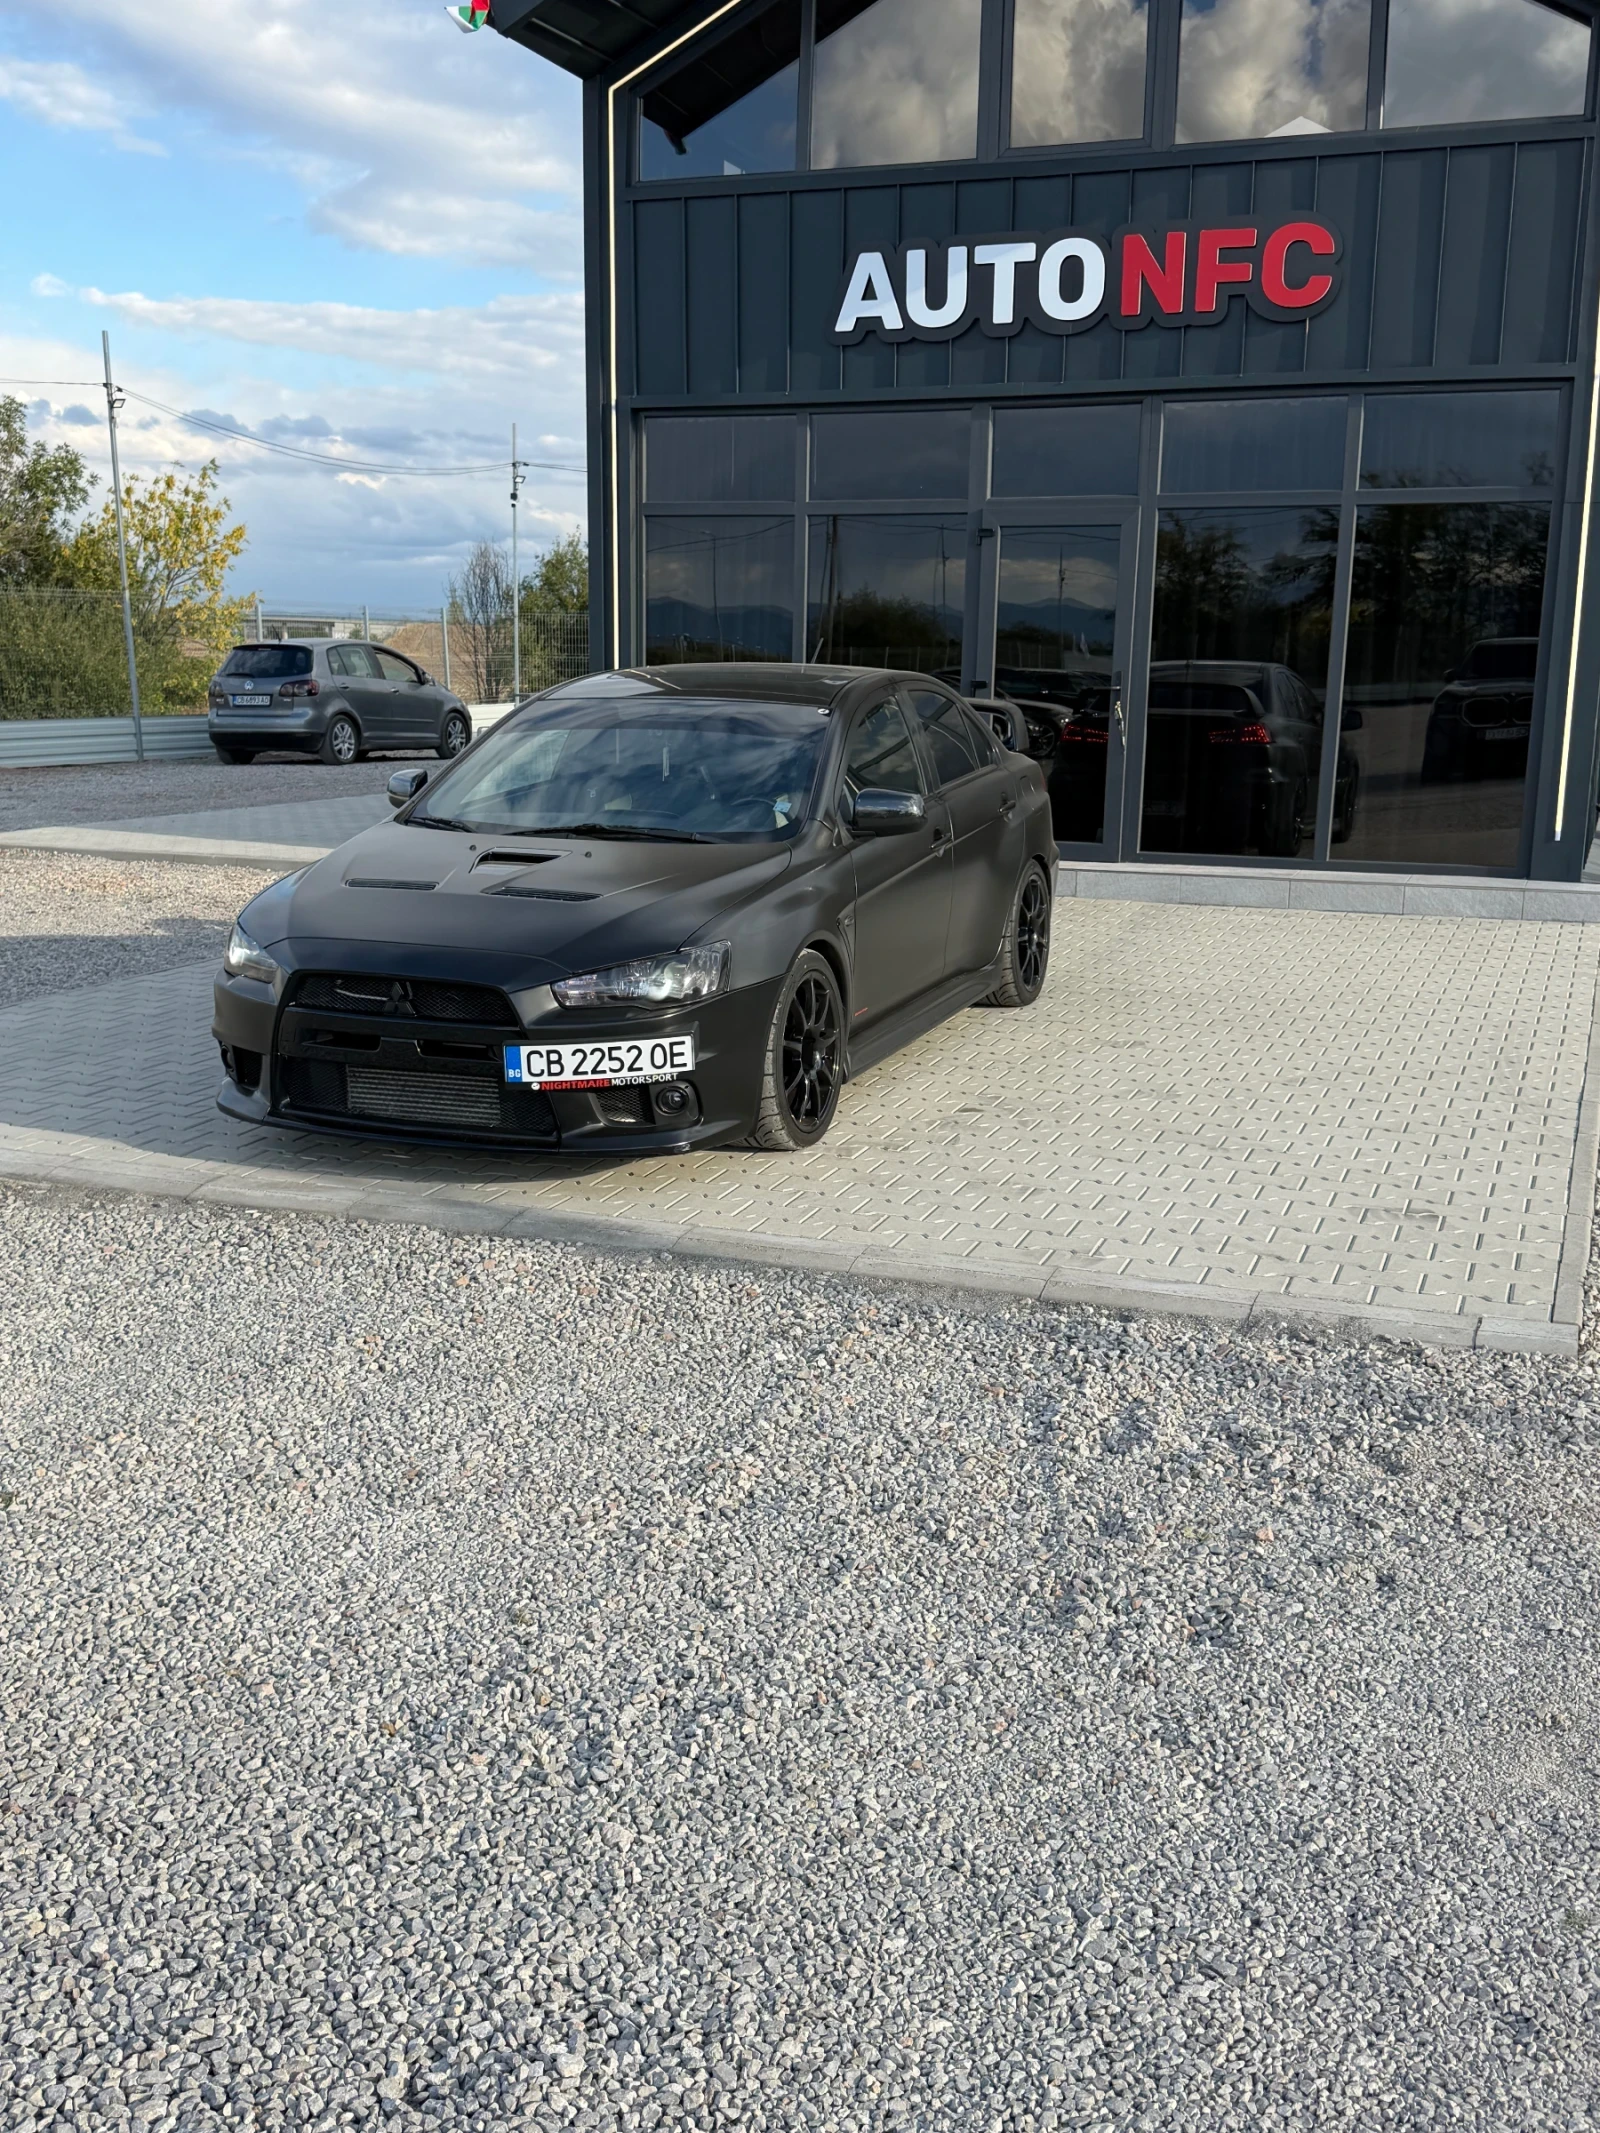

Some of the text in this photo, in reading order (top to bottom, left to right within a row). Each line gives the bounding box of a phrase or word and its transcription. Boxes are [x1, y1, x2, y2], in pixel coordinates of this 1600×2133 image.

[526, 1040, 688, 1077] CB 2252 OE
[508, 1068, 521, 1078] BG
[541, 1073, 679, 1091] NIGHTMARE MOTORSPORT
